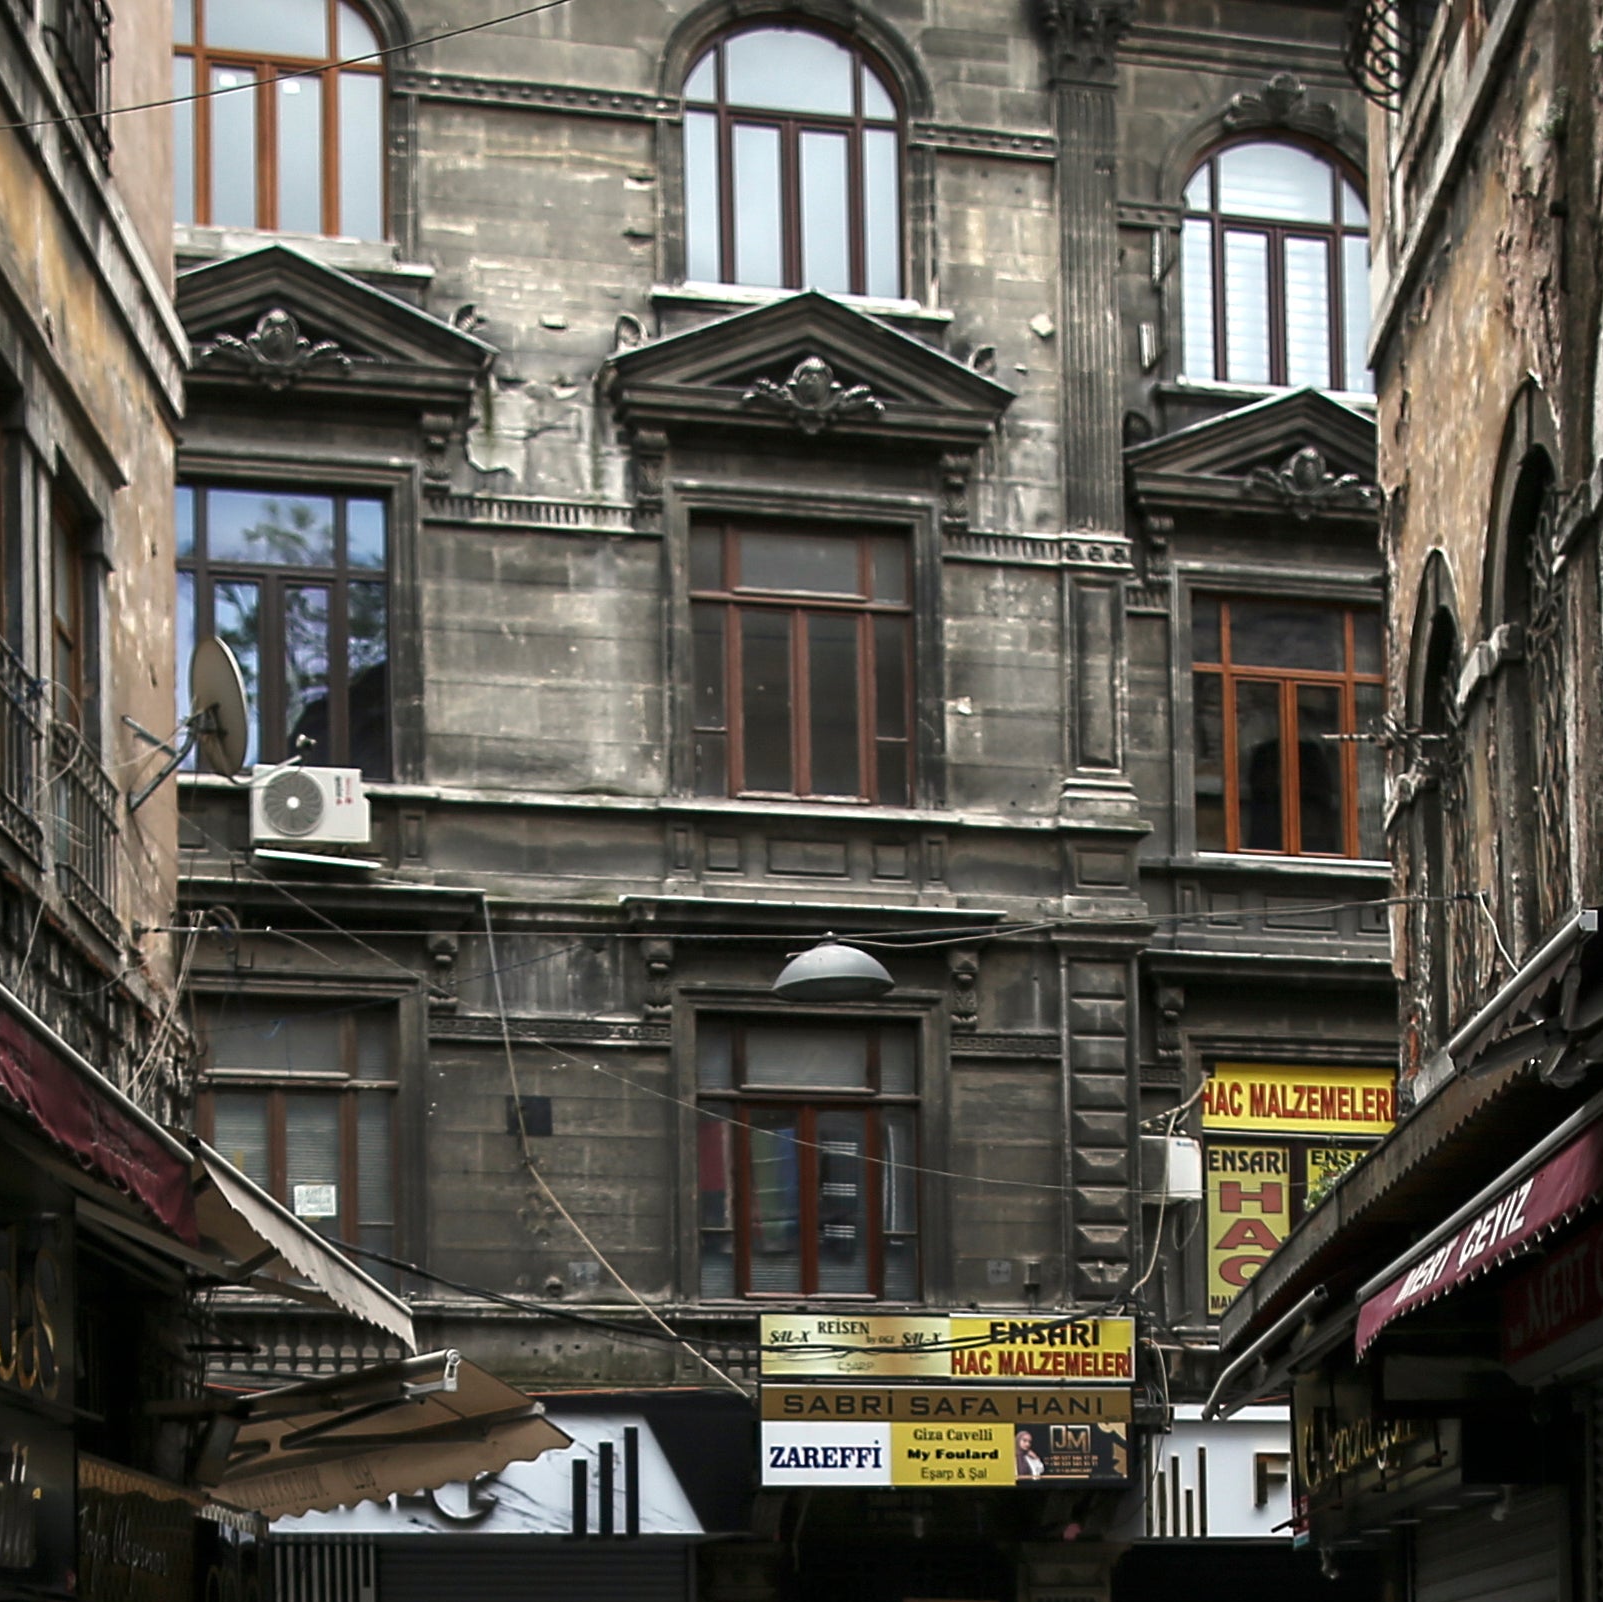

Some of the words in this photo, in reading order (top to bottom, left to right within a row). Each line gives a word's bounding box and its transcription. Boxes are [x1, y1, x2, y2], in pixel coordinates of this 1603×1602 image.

[1201, 1081, 1243, 1118] HAC
[1250, 1079, 1397, 1122] MALZEMELERİ
[1392, 1235, 1460, 1307] MERT
[817, 1317, 870, 1335] REİSEN
[951, 1350, 993, 1375] HAC
[998, 1346, 1133, 1378] MALZEMELERİ
[783, 1390, 894, 1415] SABRİ
[910, 1396, 1000, 1417] SAFA
[1016, 1396, 1103, 1416] HANI
[913, 1428, 943, 1441] Giza
[947, 1428, 993, 1442] Cavelli
[769, 1439, 882, 1469] ZAREFFİ
[907, 1449, 929, 1461] My
[935, 1448, 999, 1460] Foulard
[921, 1469, 954, 1481] Eşarp
[957, 1469, 965, 1478] &
[968, 1467, 987, 1480] Şal
